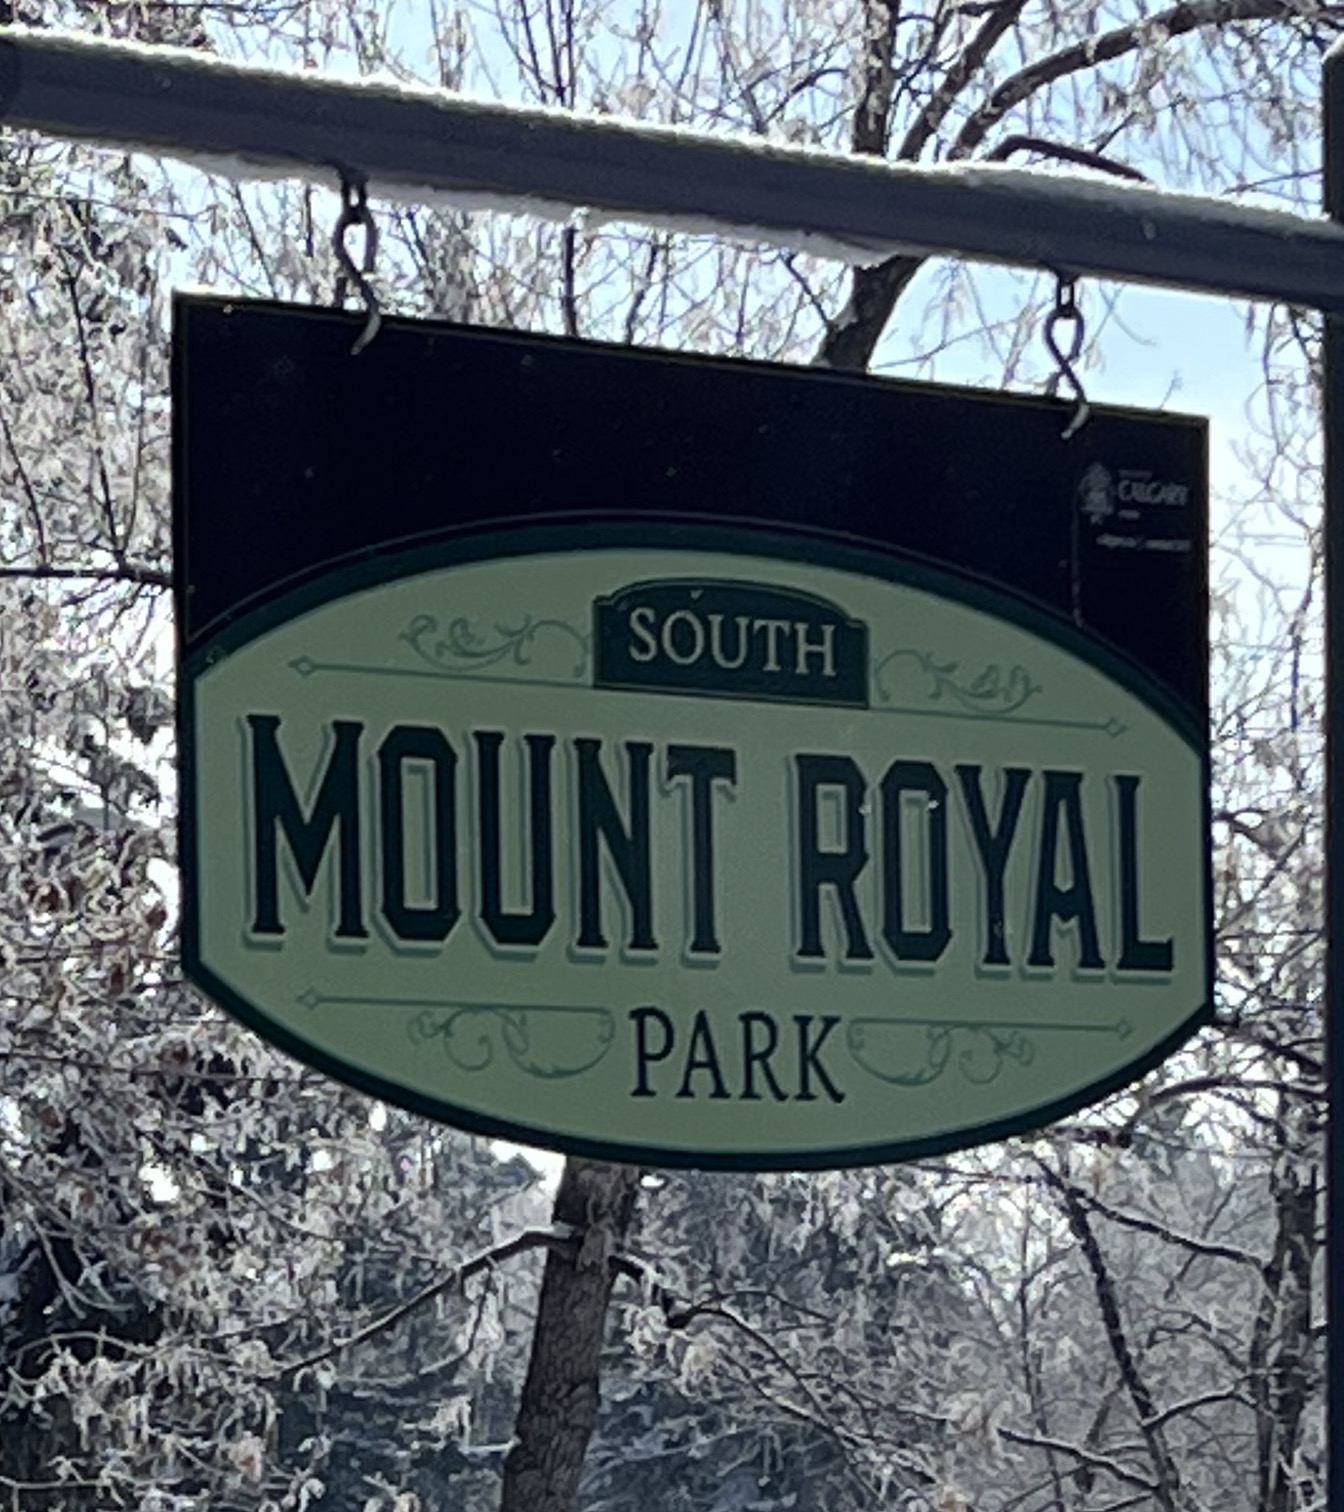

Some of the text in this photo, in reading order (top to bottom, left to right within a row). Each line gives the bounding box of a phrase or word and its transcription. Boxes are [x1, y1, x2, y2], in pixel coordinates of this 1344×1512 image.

[627, 607, 838, 679] SOUTH
[244, 713, 1176, 975] MOUNT ROYAL
[629, 1006, 846, 1105] PARK
